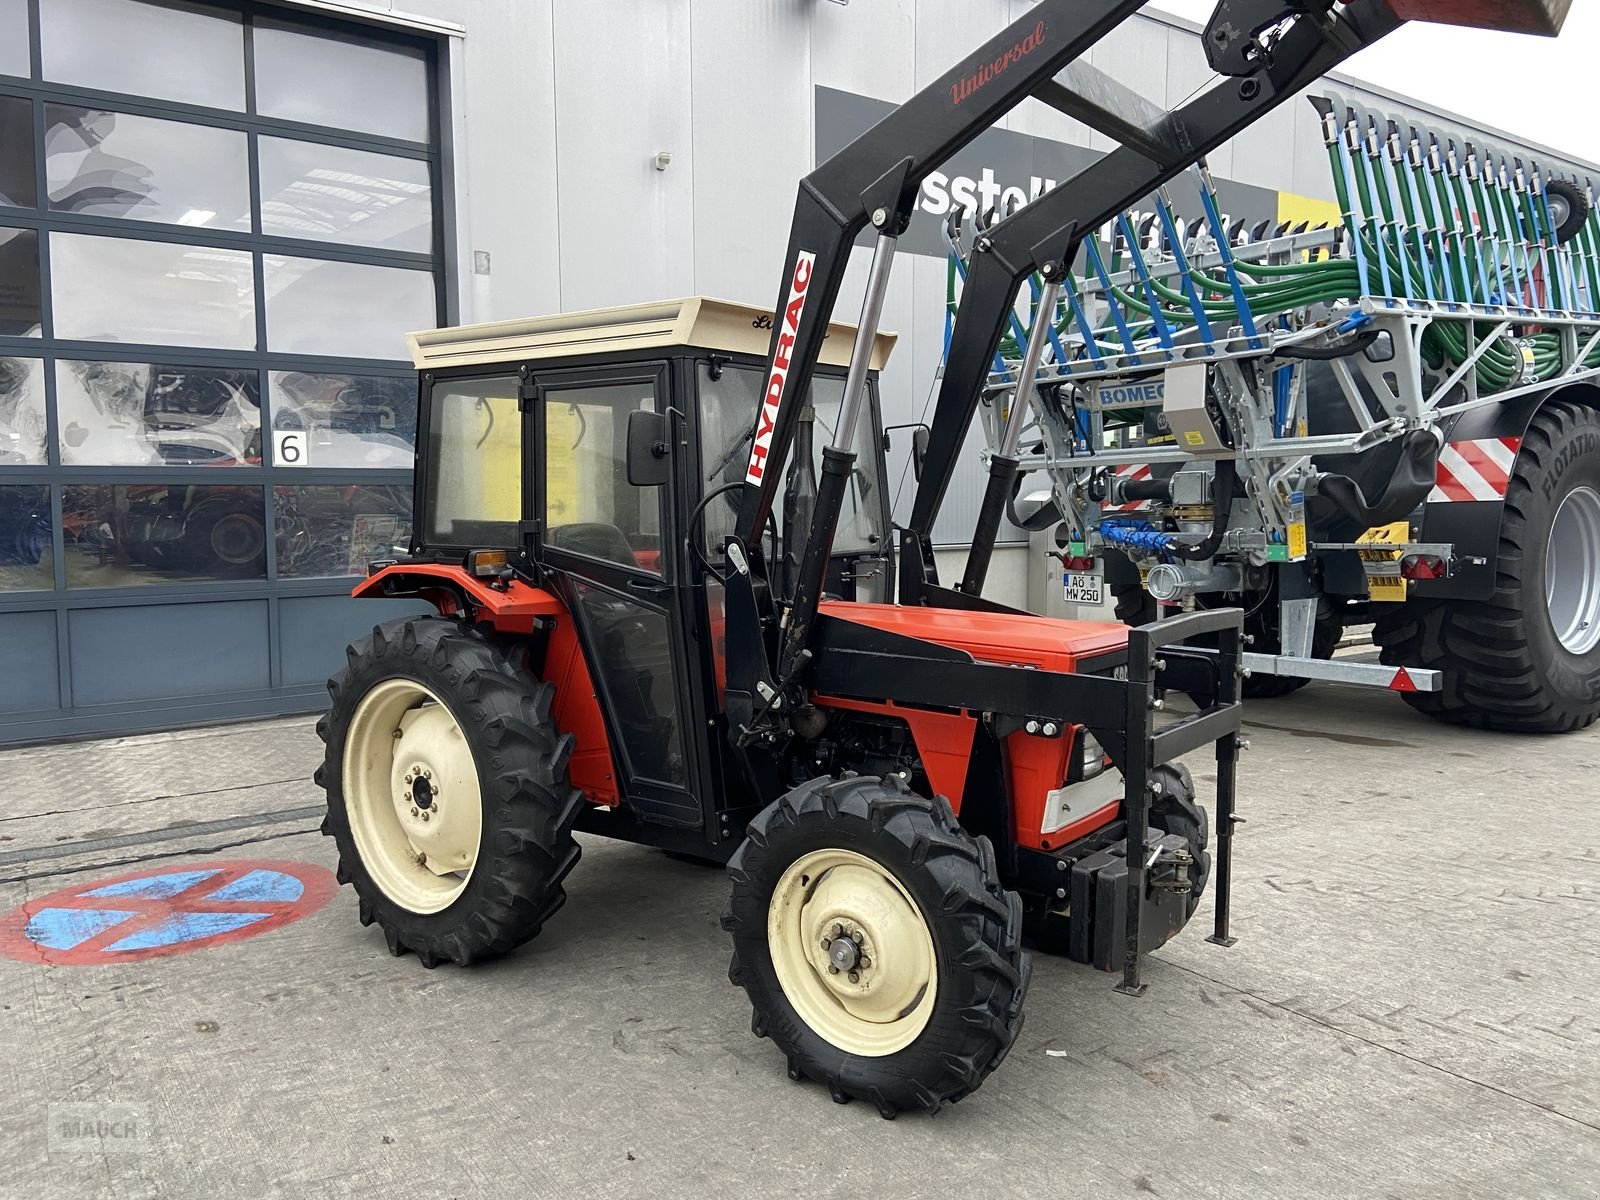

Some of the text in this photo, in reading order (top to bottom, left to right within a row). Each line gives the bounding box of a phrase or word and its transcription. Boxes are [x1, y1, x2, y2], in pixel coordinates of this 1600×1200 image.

[949, 20, 1046, 105] Universal
[749, 257, 812, 479] HYDRAC
[1100, 382, 1164, 405] BOMEC
[280, 435, 301, 463] 6
[1072, 576, 1085, 588] AÖ
[1066, 588, 1099, 602] MW 250
